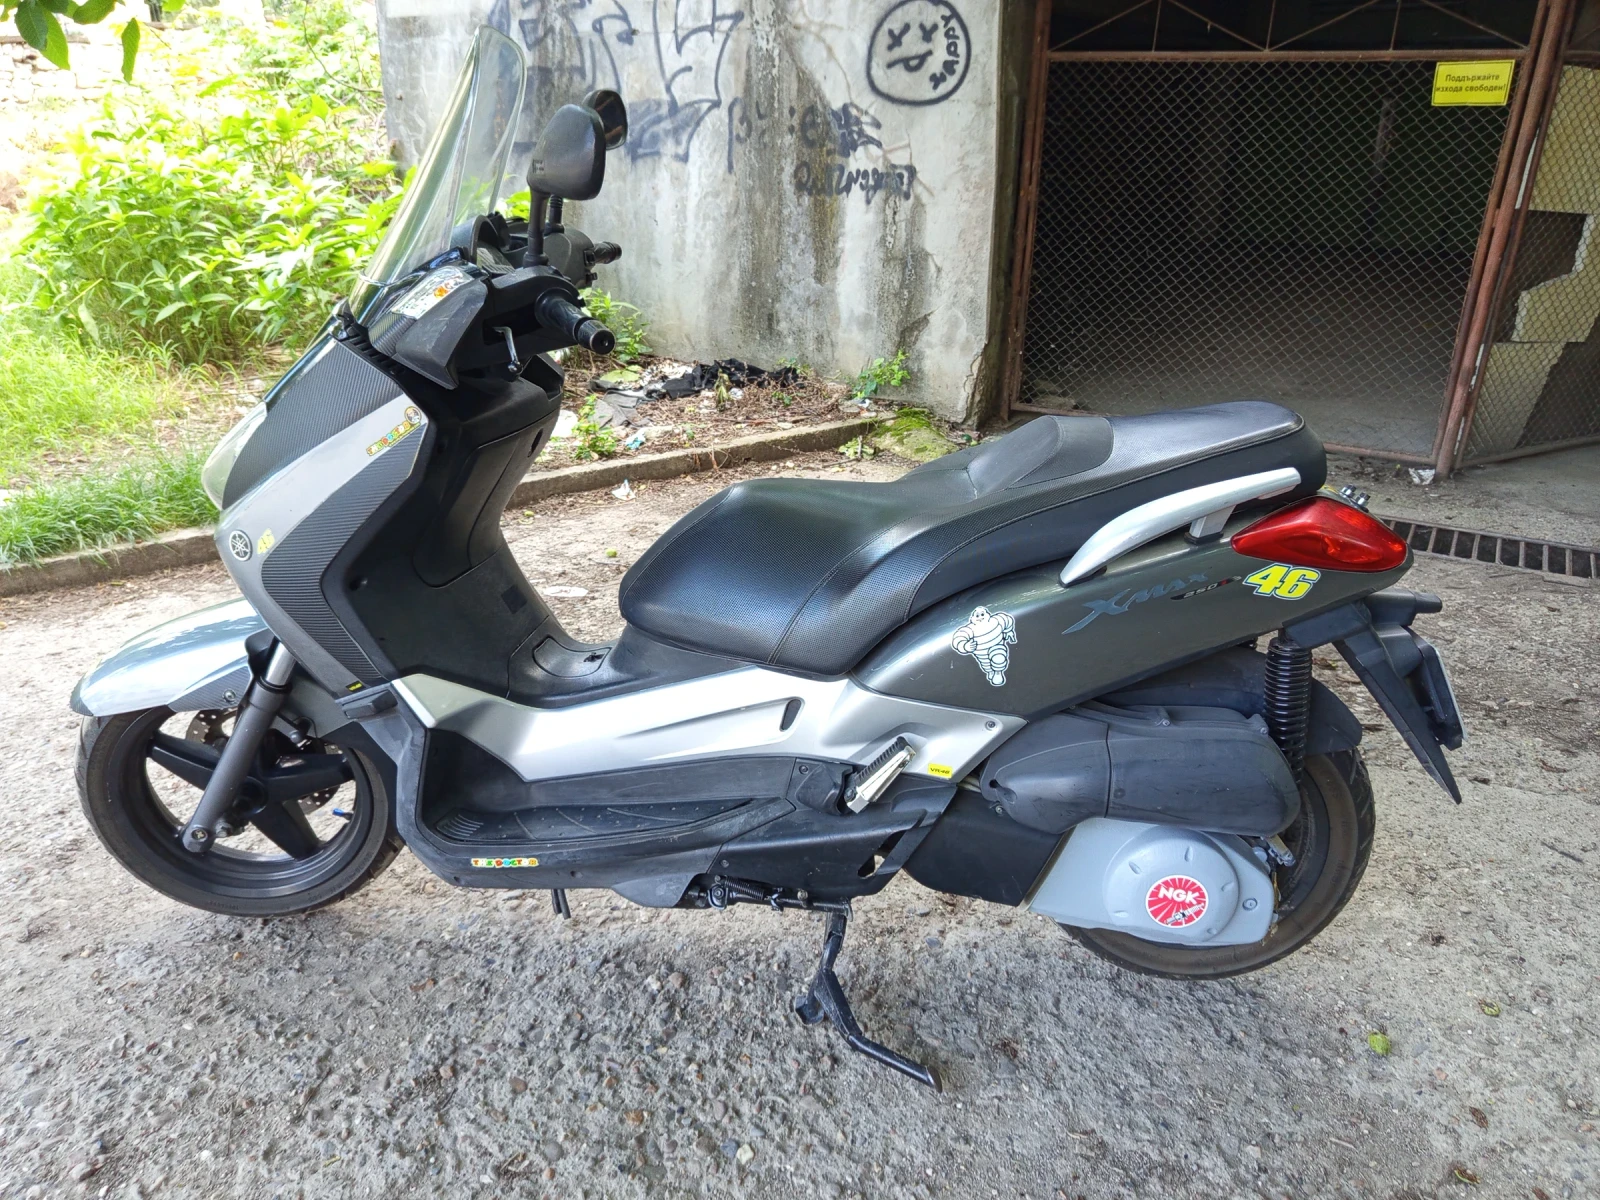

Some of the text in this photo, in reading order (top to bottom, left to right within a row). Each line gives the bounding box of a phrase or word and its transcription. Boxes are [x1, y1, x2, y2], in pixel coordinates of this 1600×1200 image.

[1445, 74, 1500, 83] Поддържайте
[1464, 84, 1507, 92] свободен!
[1243, 563, 1321, 601] 46
[471, 858, 539, 868] THE DOCTOR
[1158, 886, 1200, 905] NGK
